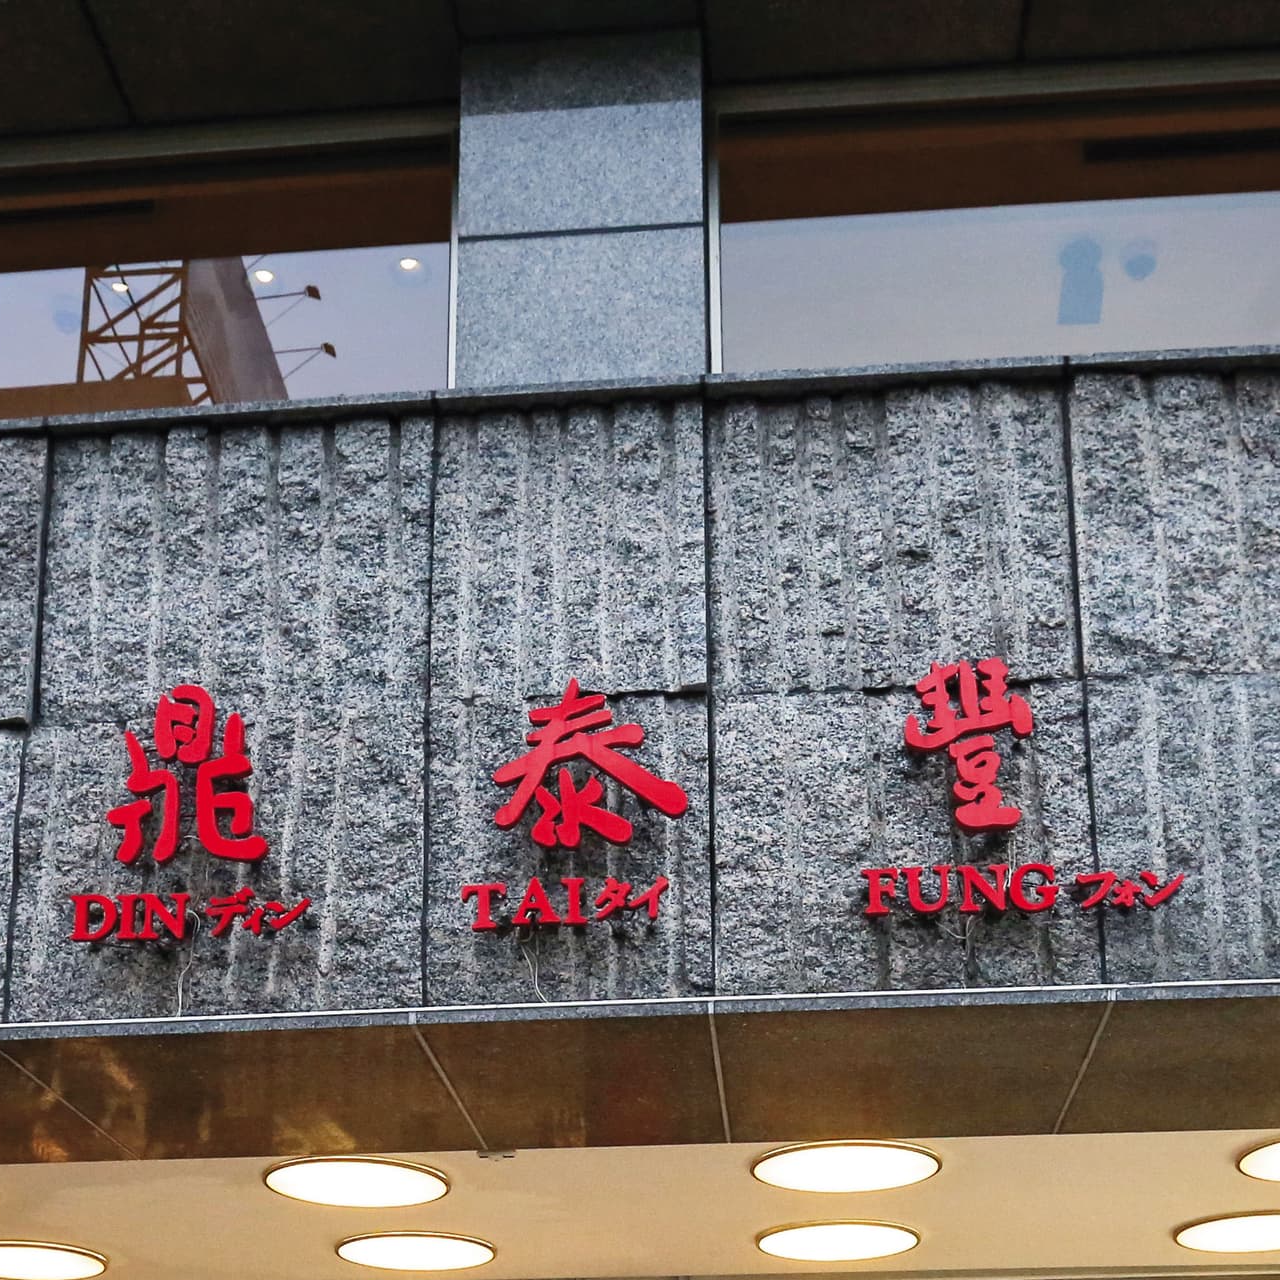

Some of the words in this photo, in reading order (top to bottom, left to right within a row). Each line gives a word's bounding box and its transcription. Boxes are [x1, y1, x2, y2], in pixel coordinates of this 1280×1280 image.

[70, 892, 191, 941] DIN
[206, 886, 311, 936] ディン
[461, 876, 588, 932] TAI
[595, 875, 669, 921] タイ
[861, 863, 1059, 917] FUNG
[1075, 870, 1184, 909] フォン
